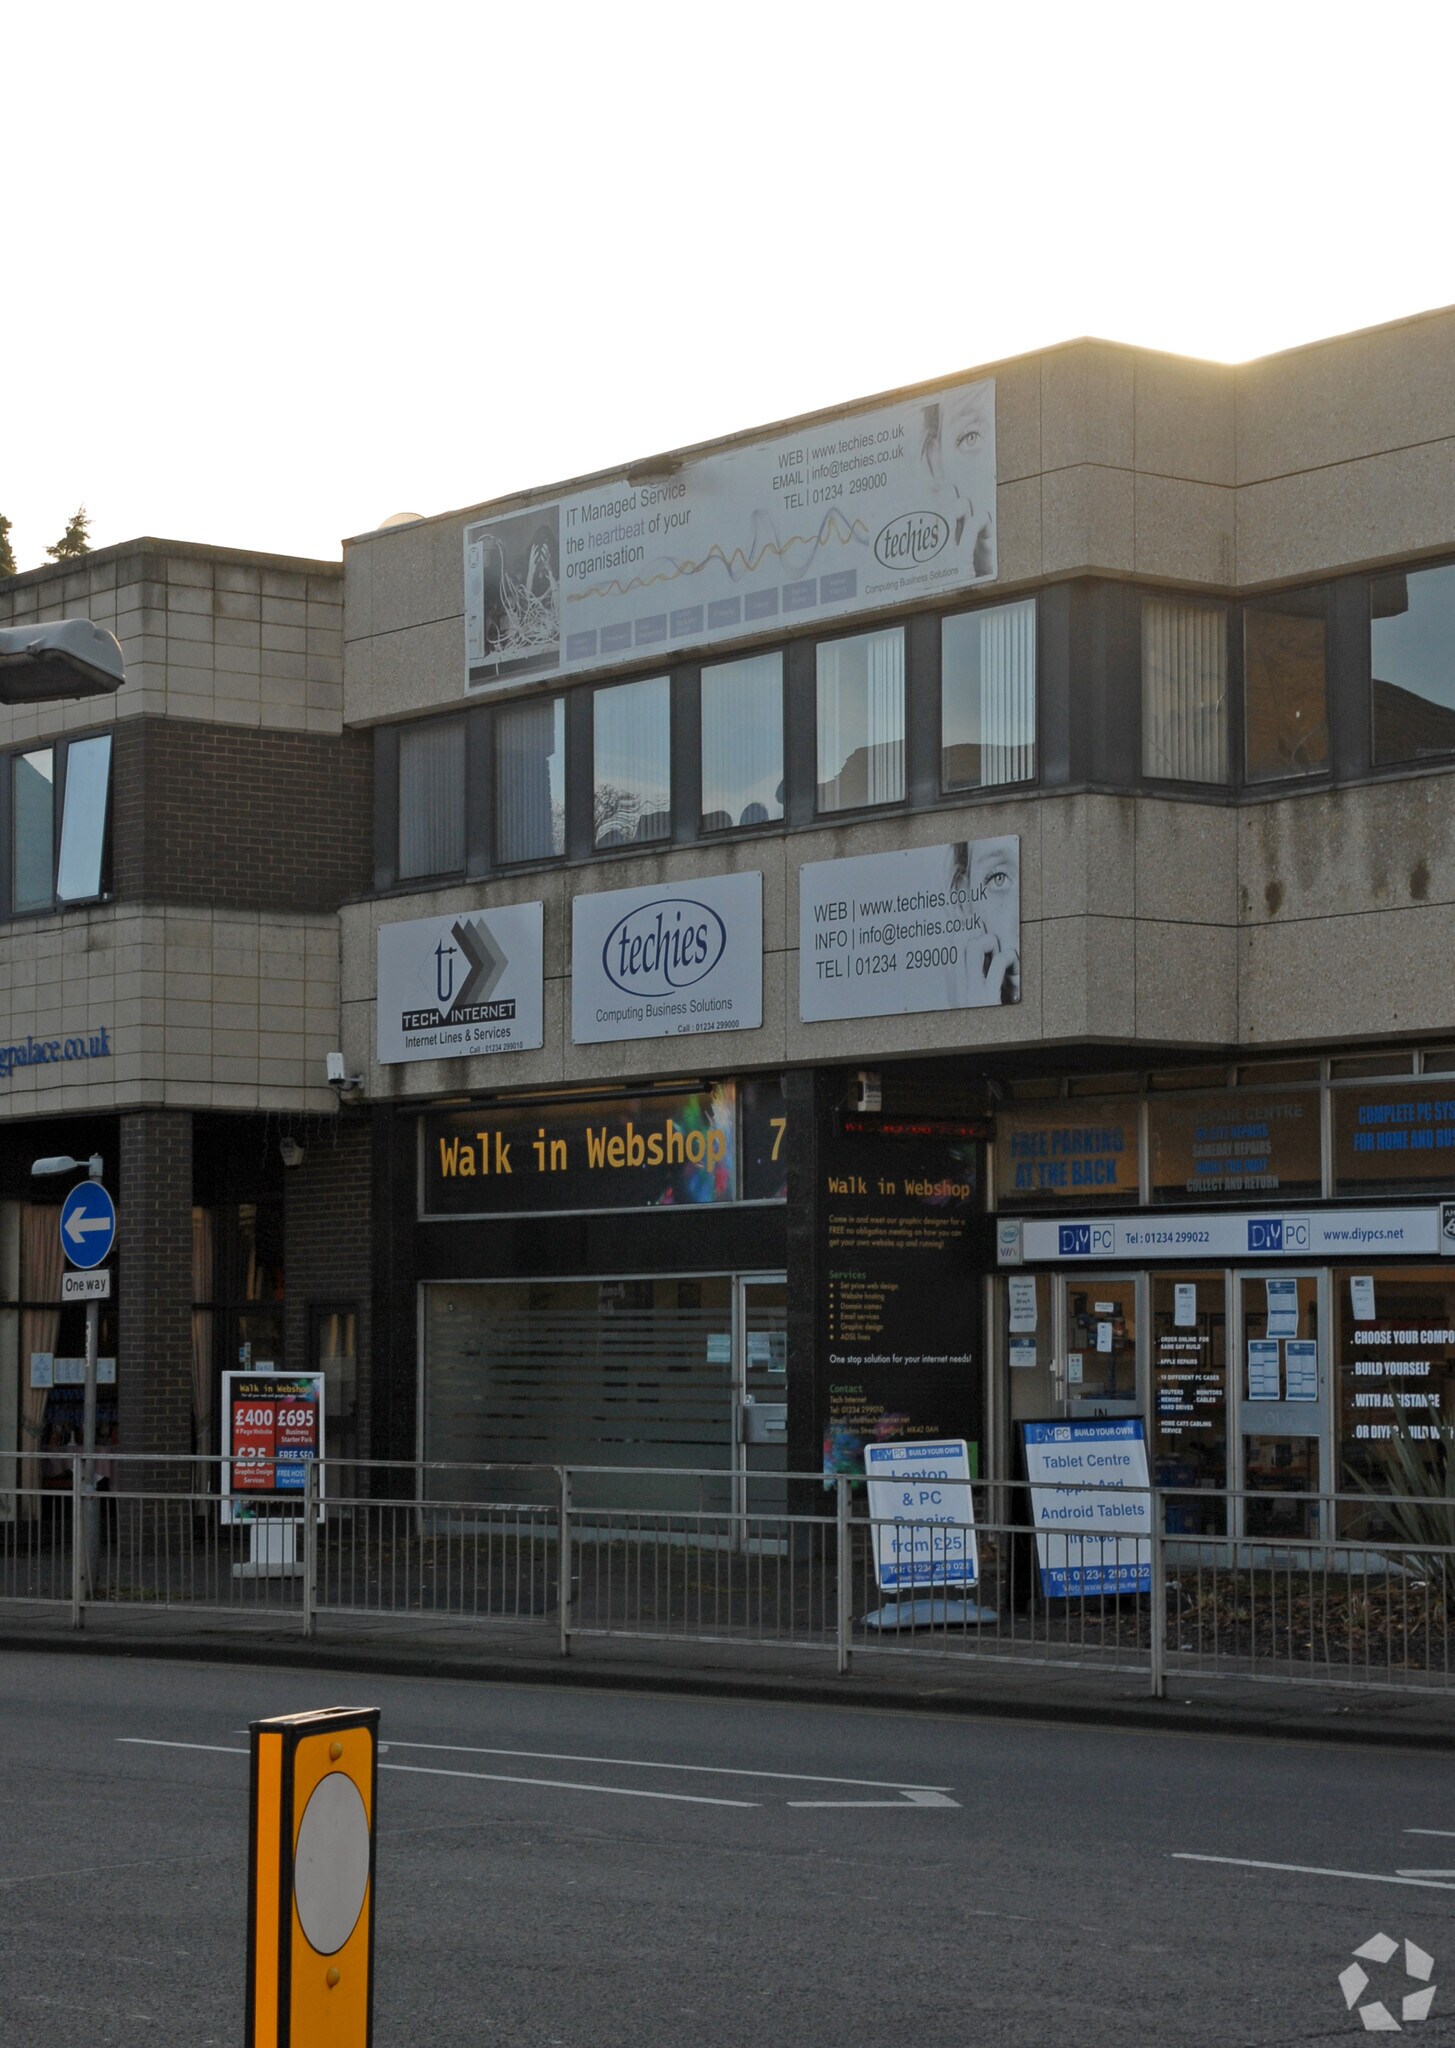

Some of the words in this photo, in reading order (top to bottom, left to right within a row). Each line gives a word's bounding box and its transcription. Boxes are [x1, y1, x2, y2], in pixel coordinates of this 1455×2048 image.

[778, 449, 803, 468] WEB
[811, 424, 904, 460] www.techies.co.uk
[772, 471, 803, 490] EMAIL
[812, 444, 904, 480] info@techies.co.uk
[784, 493, 804, 510] TEL
[812, 484, 843, 504] 01234
[849, 472, 887, 495] 299000
[566, 508, 577, 527] IT
[581, 492, 636, 523] Managed
[640, 483, 686, 507] Service
[566, 537, 585, 554] the
[588, 518, 645, 548] heartbeat
[648, 513, 661, 533] of
[664, 509, 691, 534] your
[884, 518, 939, 562] techies
[566, 544, 644, 580] organisation
[865, 581, 898, 594] Computing
[900, 574, 928, 587] Business
[929, 567, 959, 580] Solutions
[814, 901, 848, 923] WEB
[859, 883, 988, 916] www.techies.co.uk
[815, 930, 848, 950] INFO
[859, 912, 981, 945] info@techies.co.uk
[618, 911, 708, 980] techies
[815, 959, 843, 979] TEL
[855, 953, 897, 976] 01234
[906, 945, 958, 970] 299000
[403, 1012, 439, 1028] TECH
[451, 1003, 515, 1022] INTERNET
[596, 1006, 643, 1023] Computing
[646, 1002, 687, 1018] Business
[690, 998, 733, 1013] Solutions
[695, 1022, 715, 1031] 01234
[716, 1020, 740, 1029] 299000
[405, 1034, 437, 1048] Internet
[440, 1030, 462, 1044] Lines
[465, 1029, 471, 1041] &
[474, 1026, 511, 1040] Services
[1245, 1104, 1303, 1120] CENTRE
[1358, 1103, 1414, 1125] COMPLETE
[1417, 1103, 1432, 1121] PC
[1231, 1122, 1269, 1138] REPAIRS
[769, 1118, 786, 1161] 7
[1011, 1131, 1048, 1158] FREE
[1051, 1125, 1124, 1155] PARKING
[1234, 1140, 1272, 1155] REPAIRS
[1353, 1132, 1374, 1152] FOR
[1377, 1130, 1409, 1150] HOME
[1411, 1129, 1433, 1149] AND
[440, 1132, 512, 1178] Walk
[533, 1128, 567, 1172] in
[586, 1119, 725, 1173] Webshop
[1015, 1162, 1034, 1188] AT
[1038, 1161, 1067, 1187] THE
[1071, 1159, 1117, 1186] BACK
[828, 1176, 867, 1195] Walk
[878, 1177, 896, 1195] in
[904, 1178, 970, 1200] Webshop
[1186, 1178, 1222, 1192] COLLECT
[1224, 1177, 1242, 1191] AND
[1244, 1174, 1279, 1190] RETURN
[828, 1214, 847, 1223] Come
[828, 1226, 845, 1234] FREE
[1145, 1232, 1173, 1244] 01234
[1175, 1231, 1210, 1243] 299022
[1323, 1227, 1404, 1242] www.diypcs.net
[829, 1269, 867, 1280] Services
[65, 1278, 84, 1292] One
[86, 1279, 106, 1292] way
[1354, 1331, 1392, 1344] CHOOSE
[1393, 1331, 1418, 1344] YOUR
[829, 1354, 845, 1363] One
[847, 1354, 862, 1365] stop
[864, 1354, 891, 1363] solution
[892, 1353, 903, 1363] for
[904, 1356, 920, 1365] your
[922, 1354, 948, 1363] internet
[949, 1354, 972, 1363] needs!
[1355, 1362, 1383, 1375] BUILD
[1384, 1362, 1430, 1375] YOURSELF
[240, 1384, 259, 1393] Walk
[264, 1384, 273, 1393] in
[829, 1384, 863, 1393] Contact
[1355, 1393, 1380, 1407] WITH
[235, 1409, 273, 1426] £400
[277, 1409, 314, 1427] £695
[841, 1405, 860, 1414] 01234
[1074, 1428, 1095, 1437] BUILD
[1095, 1427, 1115, 1436] YOUR
[1115, 1426, 1134, 1435] OWN
[1356, 1425, 1369, 1438] OR
[279, 1451, 298, 1459] FREE
[909, 1448, 927, 1456] BUILD
[927, 1447, 944, 1455] YOUR
[945, 1446, 960, 1454] OWN
[1042, 1454, 1084, 1468] Tablet
[1087, 1453, 1131, 1467] Centre
[902, 1492, 914, 1506] &
[920, 1490, 942, 1505] PC
[1041, 1506, 1093, 1520] Android
[1097, 1503, 1145, 1517] Tablets
[891, 1538, 929, 1553] from
[934, 1536, 962, 1551] £25
